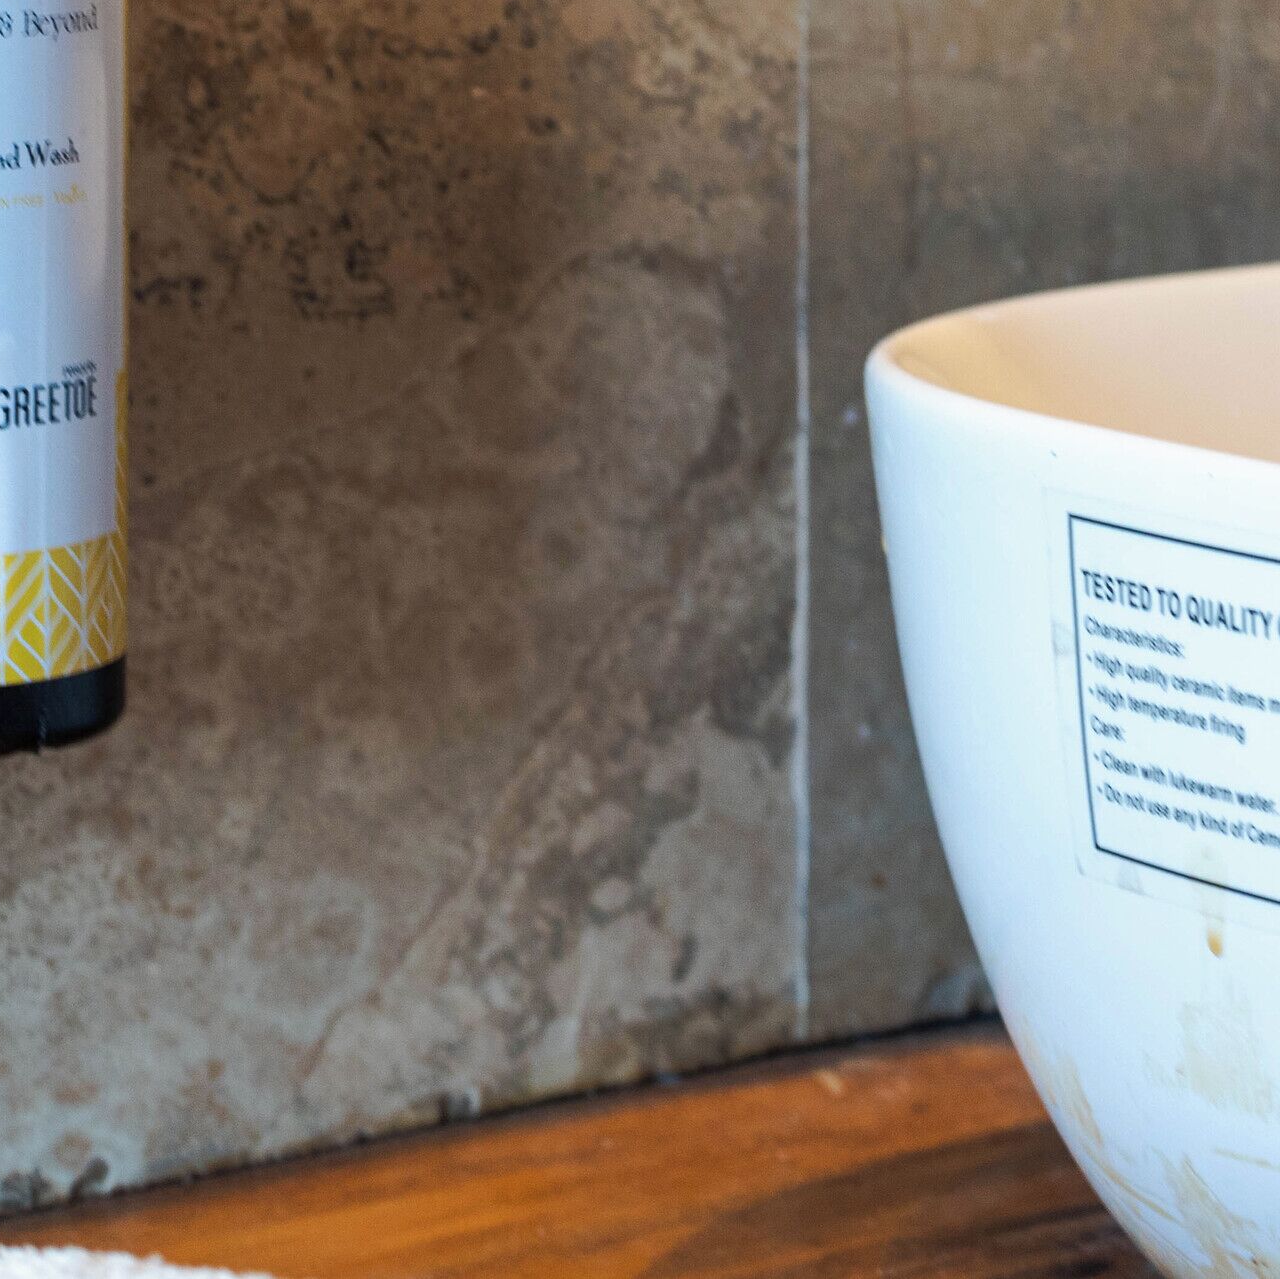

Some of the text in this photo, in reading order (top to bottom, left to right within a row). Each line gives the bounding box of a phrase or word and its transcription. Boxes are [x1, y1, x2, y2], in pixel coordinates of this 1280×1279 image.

[23, 3, 98, 42] Beyond
[23, 137, 80, 168] Wash
[1081, 569, 1152, 611] TESTED
[1156, 587, 1182, 619] TO
[1187, 595, 1272, 640] QUALITY
[1085, 614, 1185, 658] Characteristics:
[1094, 651, 1122, 678] High
[1126, 663, 1168, 692] quality
[1171, 675, 1223, 701] ceramic
[1227, 685, 1265, 712] items
[1090, 714, 1126, 742] Care:
[1095, 683, 1246, 745] High temperature firing
[1101, 749, 1139, 777] Clean
[1140, 763, 1166, 785] with
[1168, 767, 1233, 802] lukewarm
[1103, 781, 1122, 805] Do
[1124, 791, 1145, 812] not
[1146, 799, 1170, 820] use
[1172, 806, 1197, 831] any
[1198, 810, 1228, 836] kind
[1230, 821, 1244, 839] of
